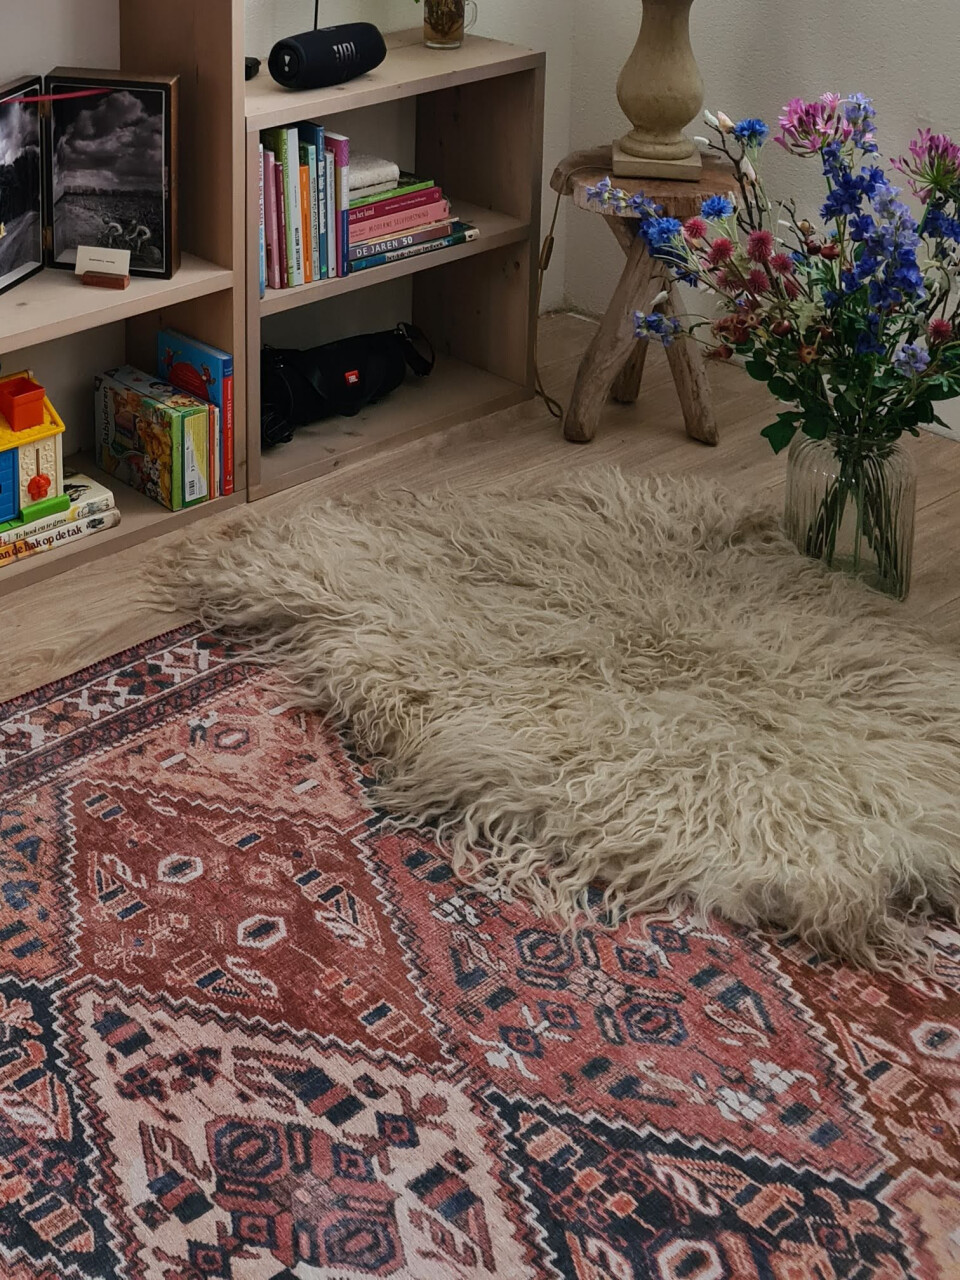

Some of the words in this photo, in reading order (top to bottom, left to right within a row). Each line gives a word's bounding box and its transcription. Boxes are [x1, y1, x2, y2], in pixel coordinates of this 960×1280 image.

[356, 248, 368, 257] DE
[370, 240, 398, 255] JAREN
[400, 235, 414, 247] '50
[102, 386, 111, 445] Babydieren
[11, 543, 24, 556] de
[24, 536, 42, 551] hak
[45, 536, 55, 549] op
[55, 530, 68, 542] de
[67, 524, 83, 538] tak
[15, 531, 24, 540] Te
[24, 527, 38, 538] hooi
[37, 525, 46, 533] en
[46, 522, 53, 532] te
[52, 519, 68, 532] gras
